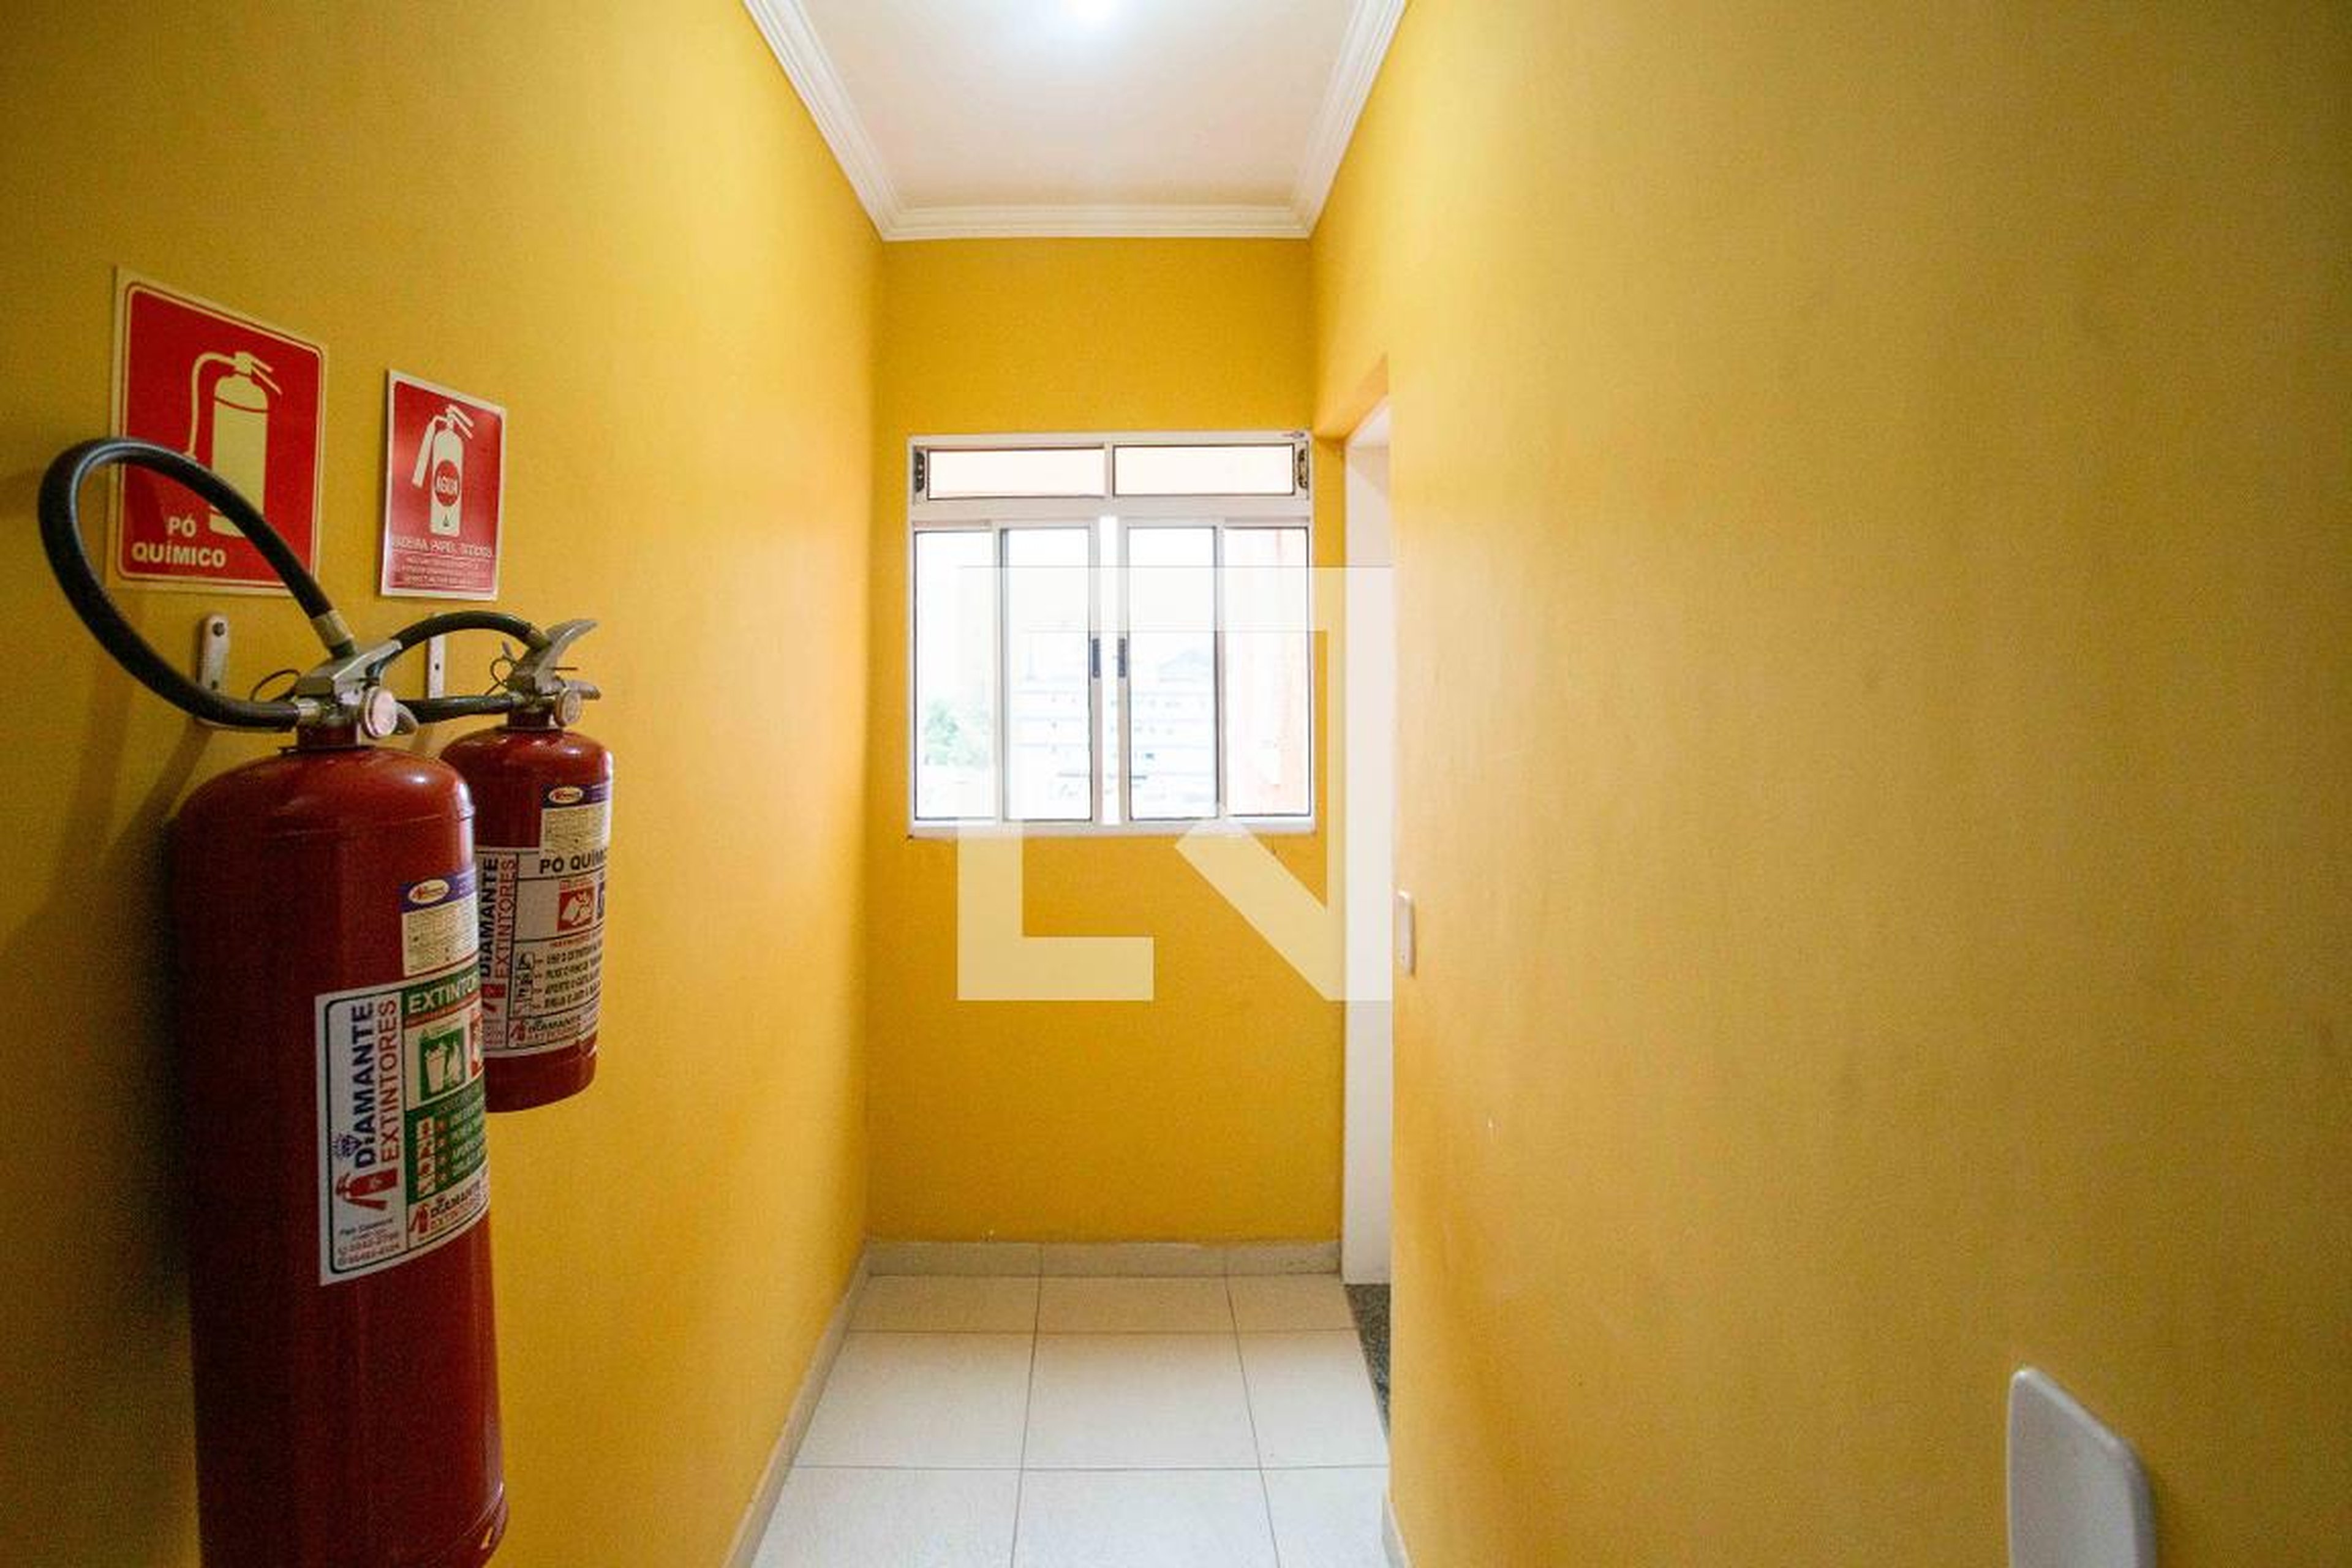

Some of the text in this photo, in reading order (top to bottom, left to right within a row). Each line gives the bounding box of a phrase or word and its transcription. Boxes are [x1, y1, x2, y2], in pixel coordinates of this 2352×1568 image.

[168, 513, 197, 538] PÓ
[132, 540, 227, 568] QUÍMICO
[379, 1000, 400, 1163] EXTINTORES
